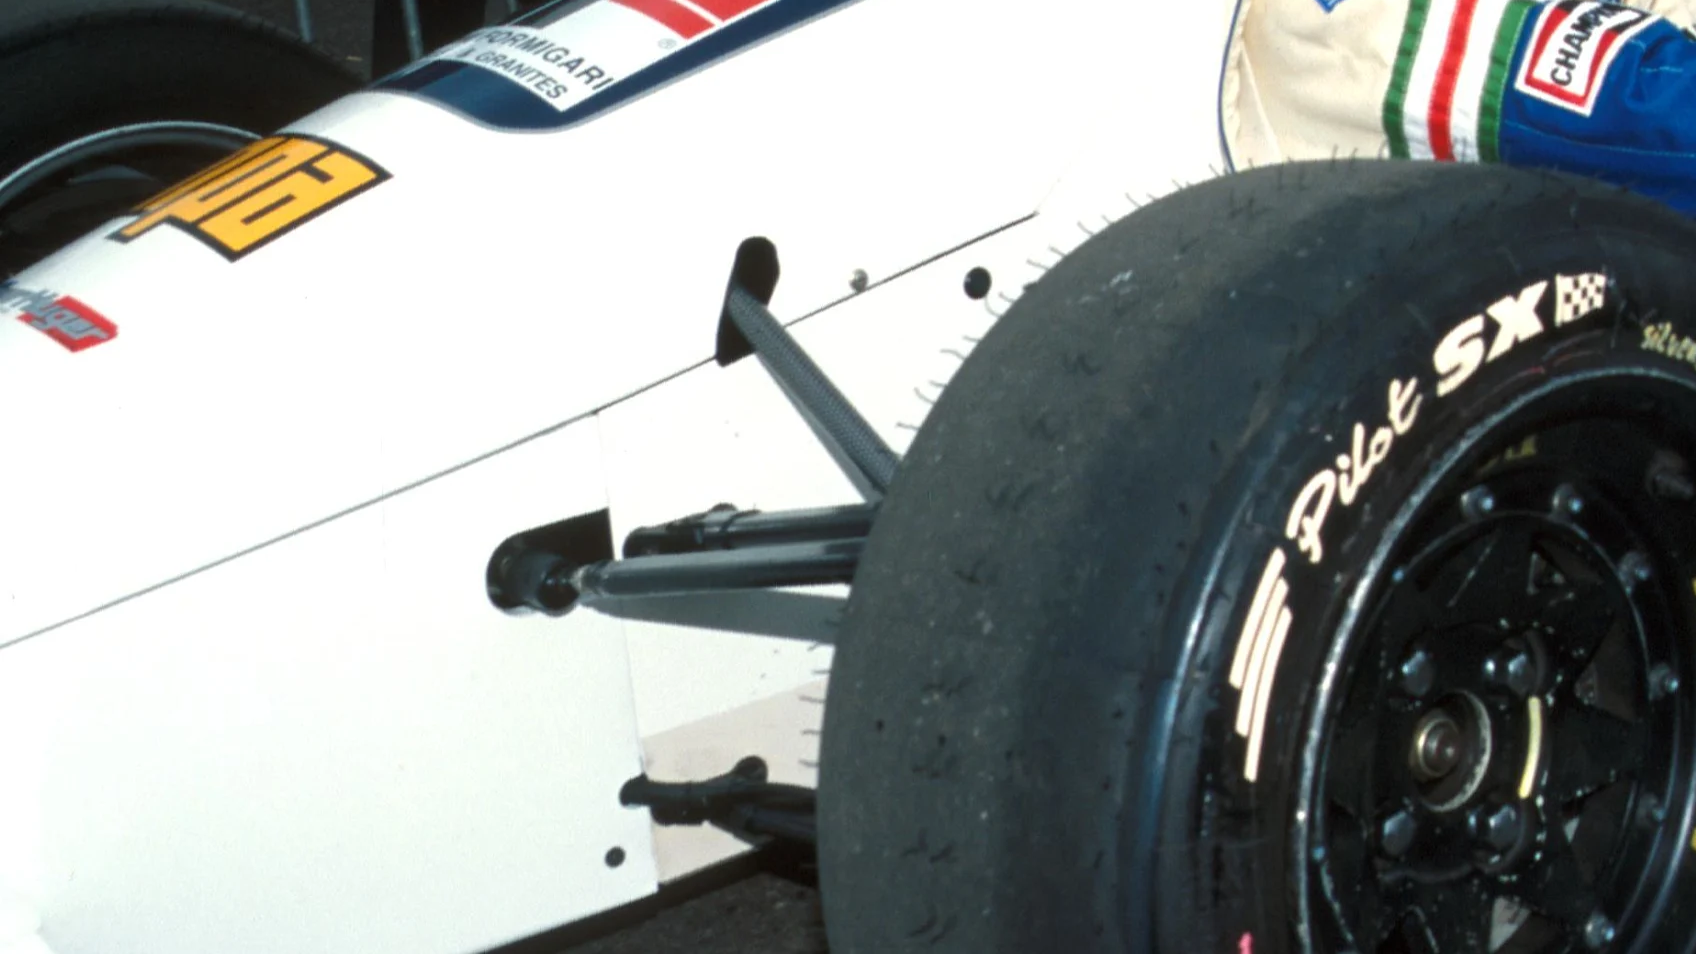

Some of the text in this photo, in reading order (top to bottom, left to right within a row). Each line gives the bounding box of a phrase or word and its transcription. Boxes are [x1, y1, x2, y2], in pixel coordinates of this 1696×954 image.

[475, 50, 568, 100] GRANITES
[1285, 280, 1549, 564] Pilot SX
